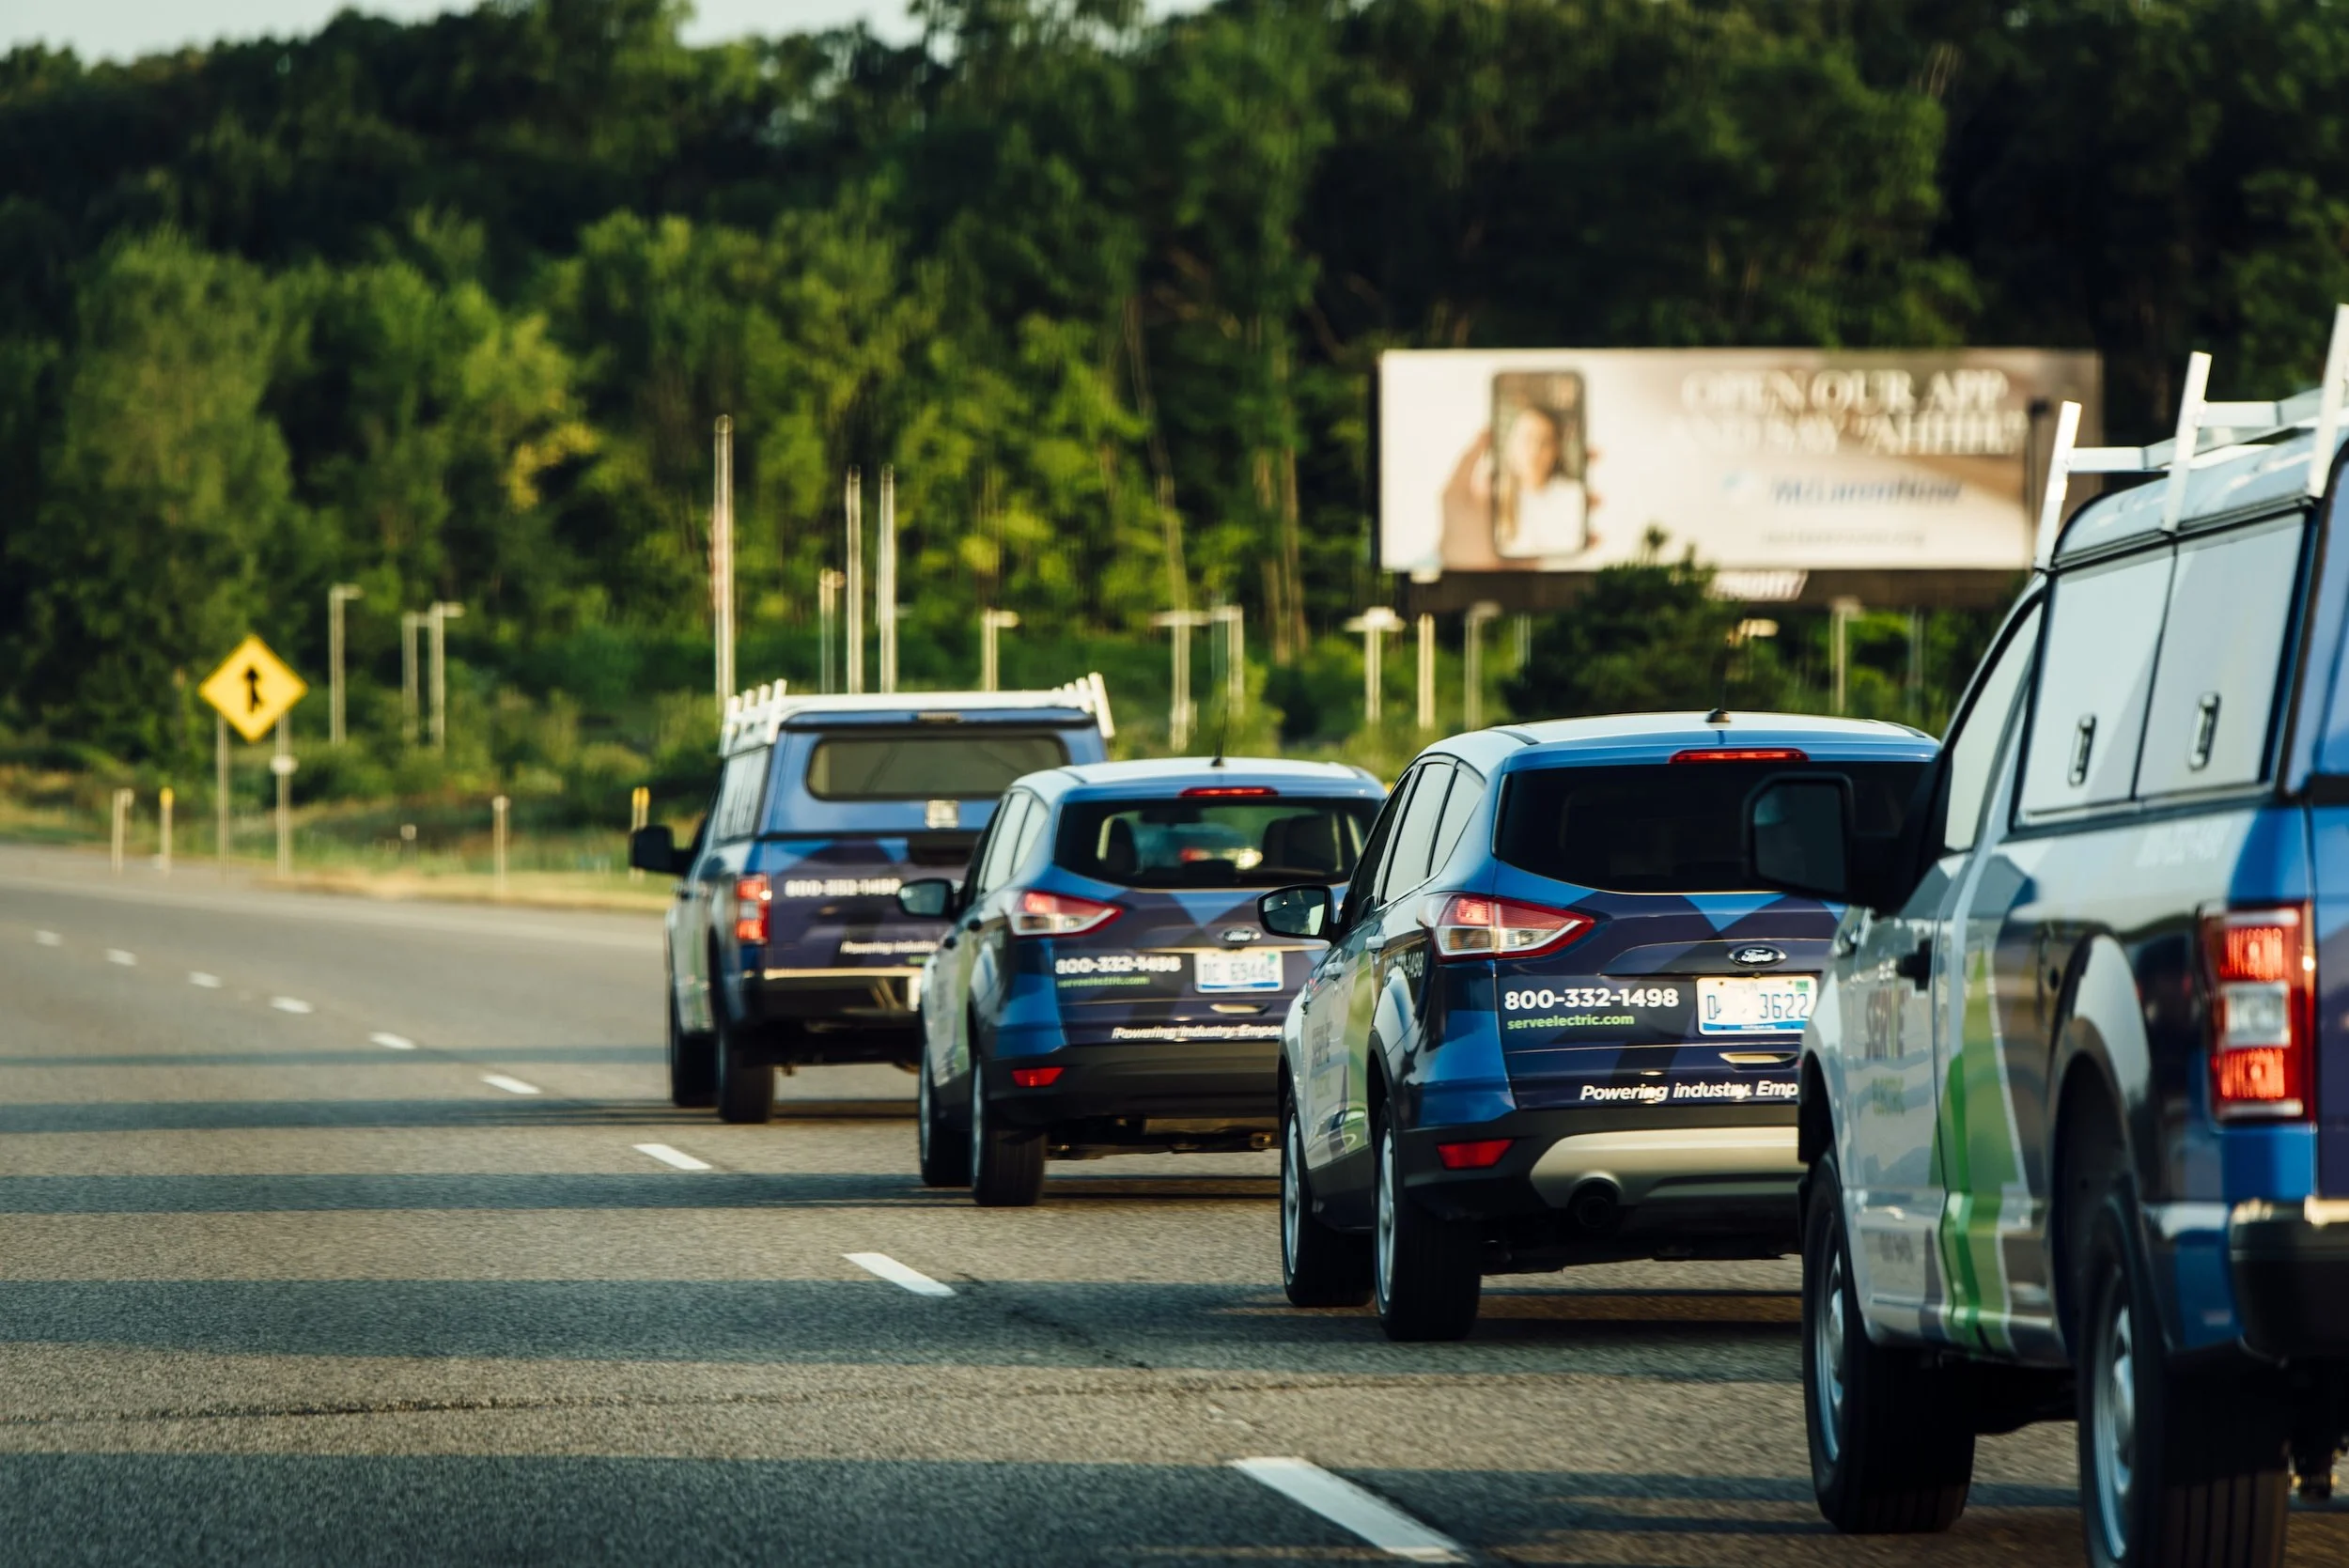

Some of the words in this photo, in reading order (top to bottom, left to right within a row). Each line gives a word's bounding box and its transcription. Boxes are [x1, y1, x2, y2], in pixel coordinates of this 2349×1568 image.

[1811, 369, 1916, 414] OUR
[1741, 948, 1774, 963] Ford
[1504, 988, 1679, 1011] 800-332-1498
[1507, 1014, 1635, 1030] serveelectric.com
[1579, 1084, 1669, 1101] Powering
[1672, 1082, 1752, 1099] industry.
